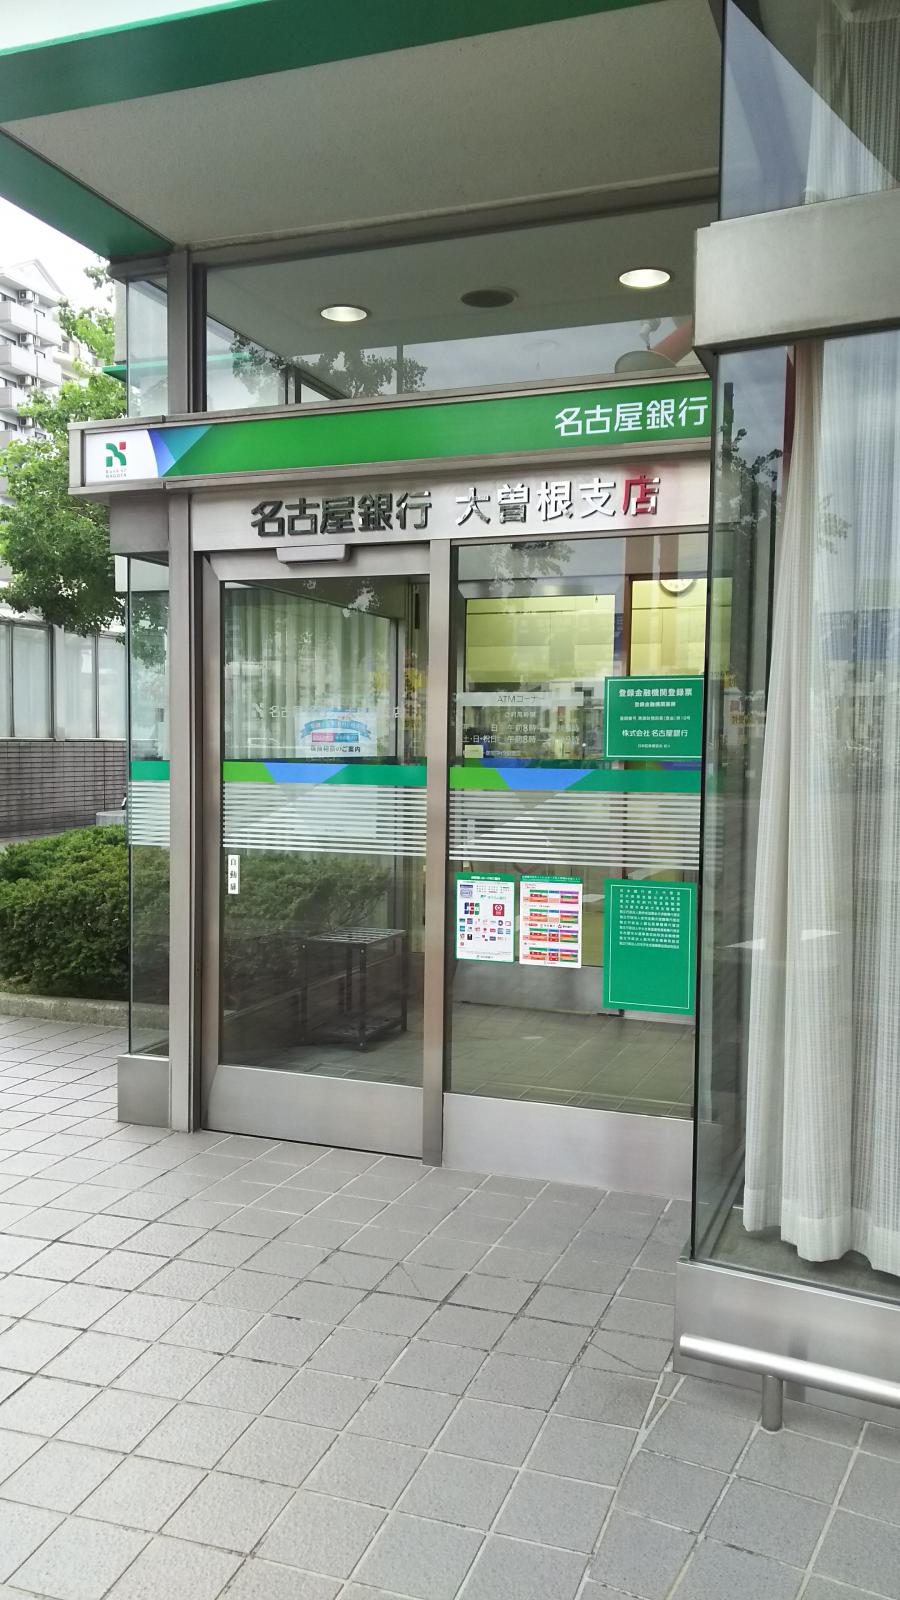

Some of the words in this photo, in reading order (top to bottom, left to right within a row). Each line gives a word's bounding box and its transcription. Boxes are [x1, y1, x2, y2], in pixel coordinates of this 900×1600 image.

[554, 396, 708, 437] 名古屋銀行
[251, 491, 433, 537] 名古屋銀行
[455, 474, 661, 526] 大曽根支店
[496, 694, 546, 704] ATMコーナー
[651, 728, 689, 738] 名古屋銀行
